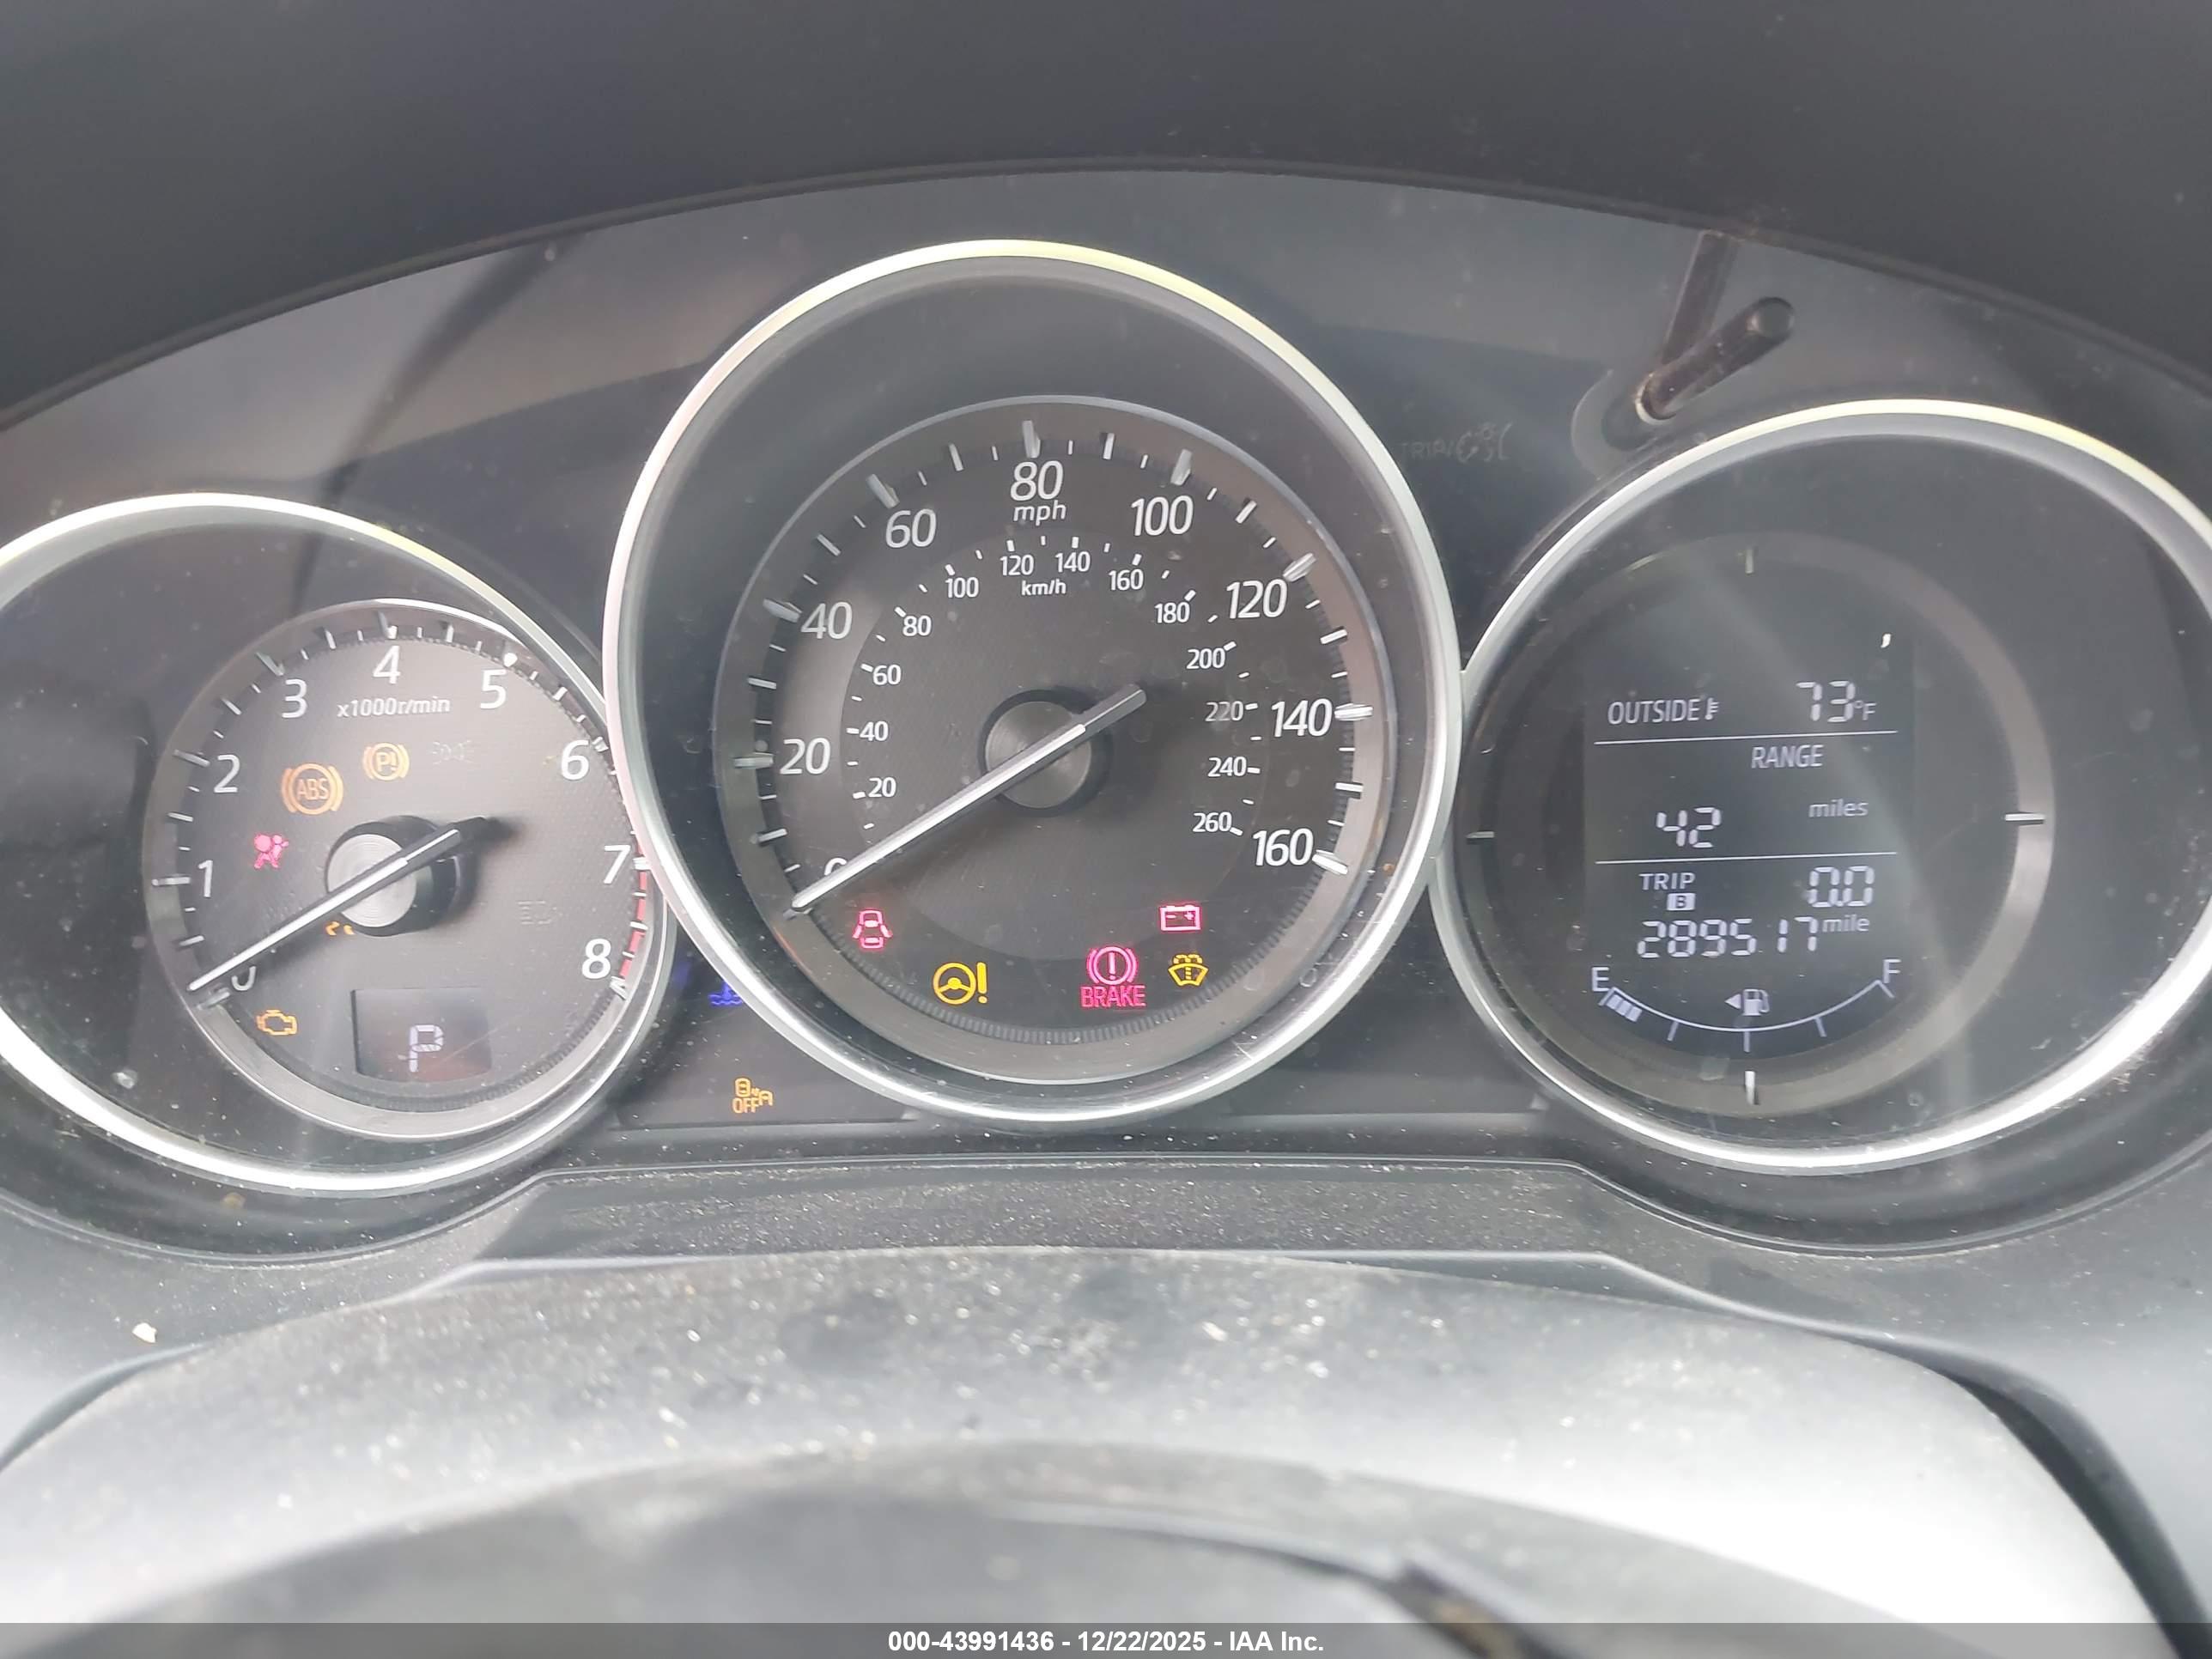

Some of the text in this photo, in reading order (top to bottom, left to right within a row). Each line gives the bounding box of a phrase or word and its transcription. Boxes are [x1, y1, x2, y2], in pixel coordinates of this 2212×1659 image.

[1010, 460, 1063, 500] 80
[1013, 500, 1066, 525] mph
[1132, 496, 1194, 537] 100
[885, 508, 937, 549] 60
[1000, 554, 1035, 575] 120
[1054, 551, 1091, 574] 140
[945, 576, 979, 599] 100
[1021, 579, 1066, 597] km/h
[1108, 568, 1144, 591] 160
[1227, 579, 1287, 618] 120
[803, 602, 852, 640] 40
[1155, 602, 1190, 623] 180
[902, 615, 932, 636] 80
[373, 646, 400, 684] 4
[1186, 648, 1226, 670] 200
[872, 665, 902, 686] 60
[283, 679, 308, 717] 3
[480, 670, 507, 709] 5
[337, 697, 451, 717] x1000r/min
[1206, 702, 1244, 722] 220
[1271, 700, 1331, 738] 140
[1608, 699, 1700, 725] OUTSIDE
[860, 721, 889, 742] 40
[561, 740, 589, 779] 6
[781, 738, 831, 775] 20
[1207, 757, 1247, 777] 240
[1752, 744, 1824, 769] RANGE
[214, 755, 238, 793] 2
[297, 777, 329, 800] ABS
[867, 778, 896, 799] 20
[1193, 812, 1231, 833] 260
[1656, 799, 1869, 848] 42 miles
[1253, 829, 1312, 866] 160
[602, 845, 631, 884] 7
[198, 860, 211, 897] 1
[1639, 872, 1695, 890] TRIP
[1638, 915, 1869, 958] 289517 mile
[581, 938, 611, 979] 8
[1883, 959, 1901, 982] F
[1591, 967, 1609, 992] E
[1081, 986, 1146, 1008] BRAKE
[408, 1024, 443, 1072] P
